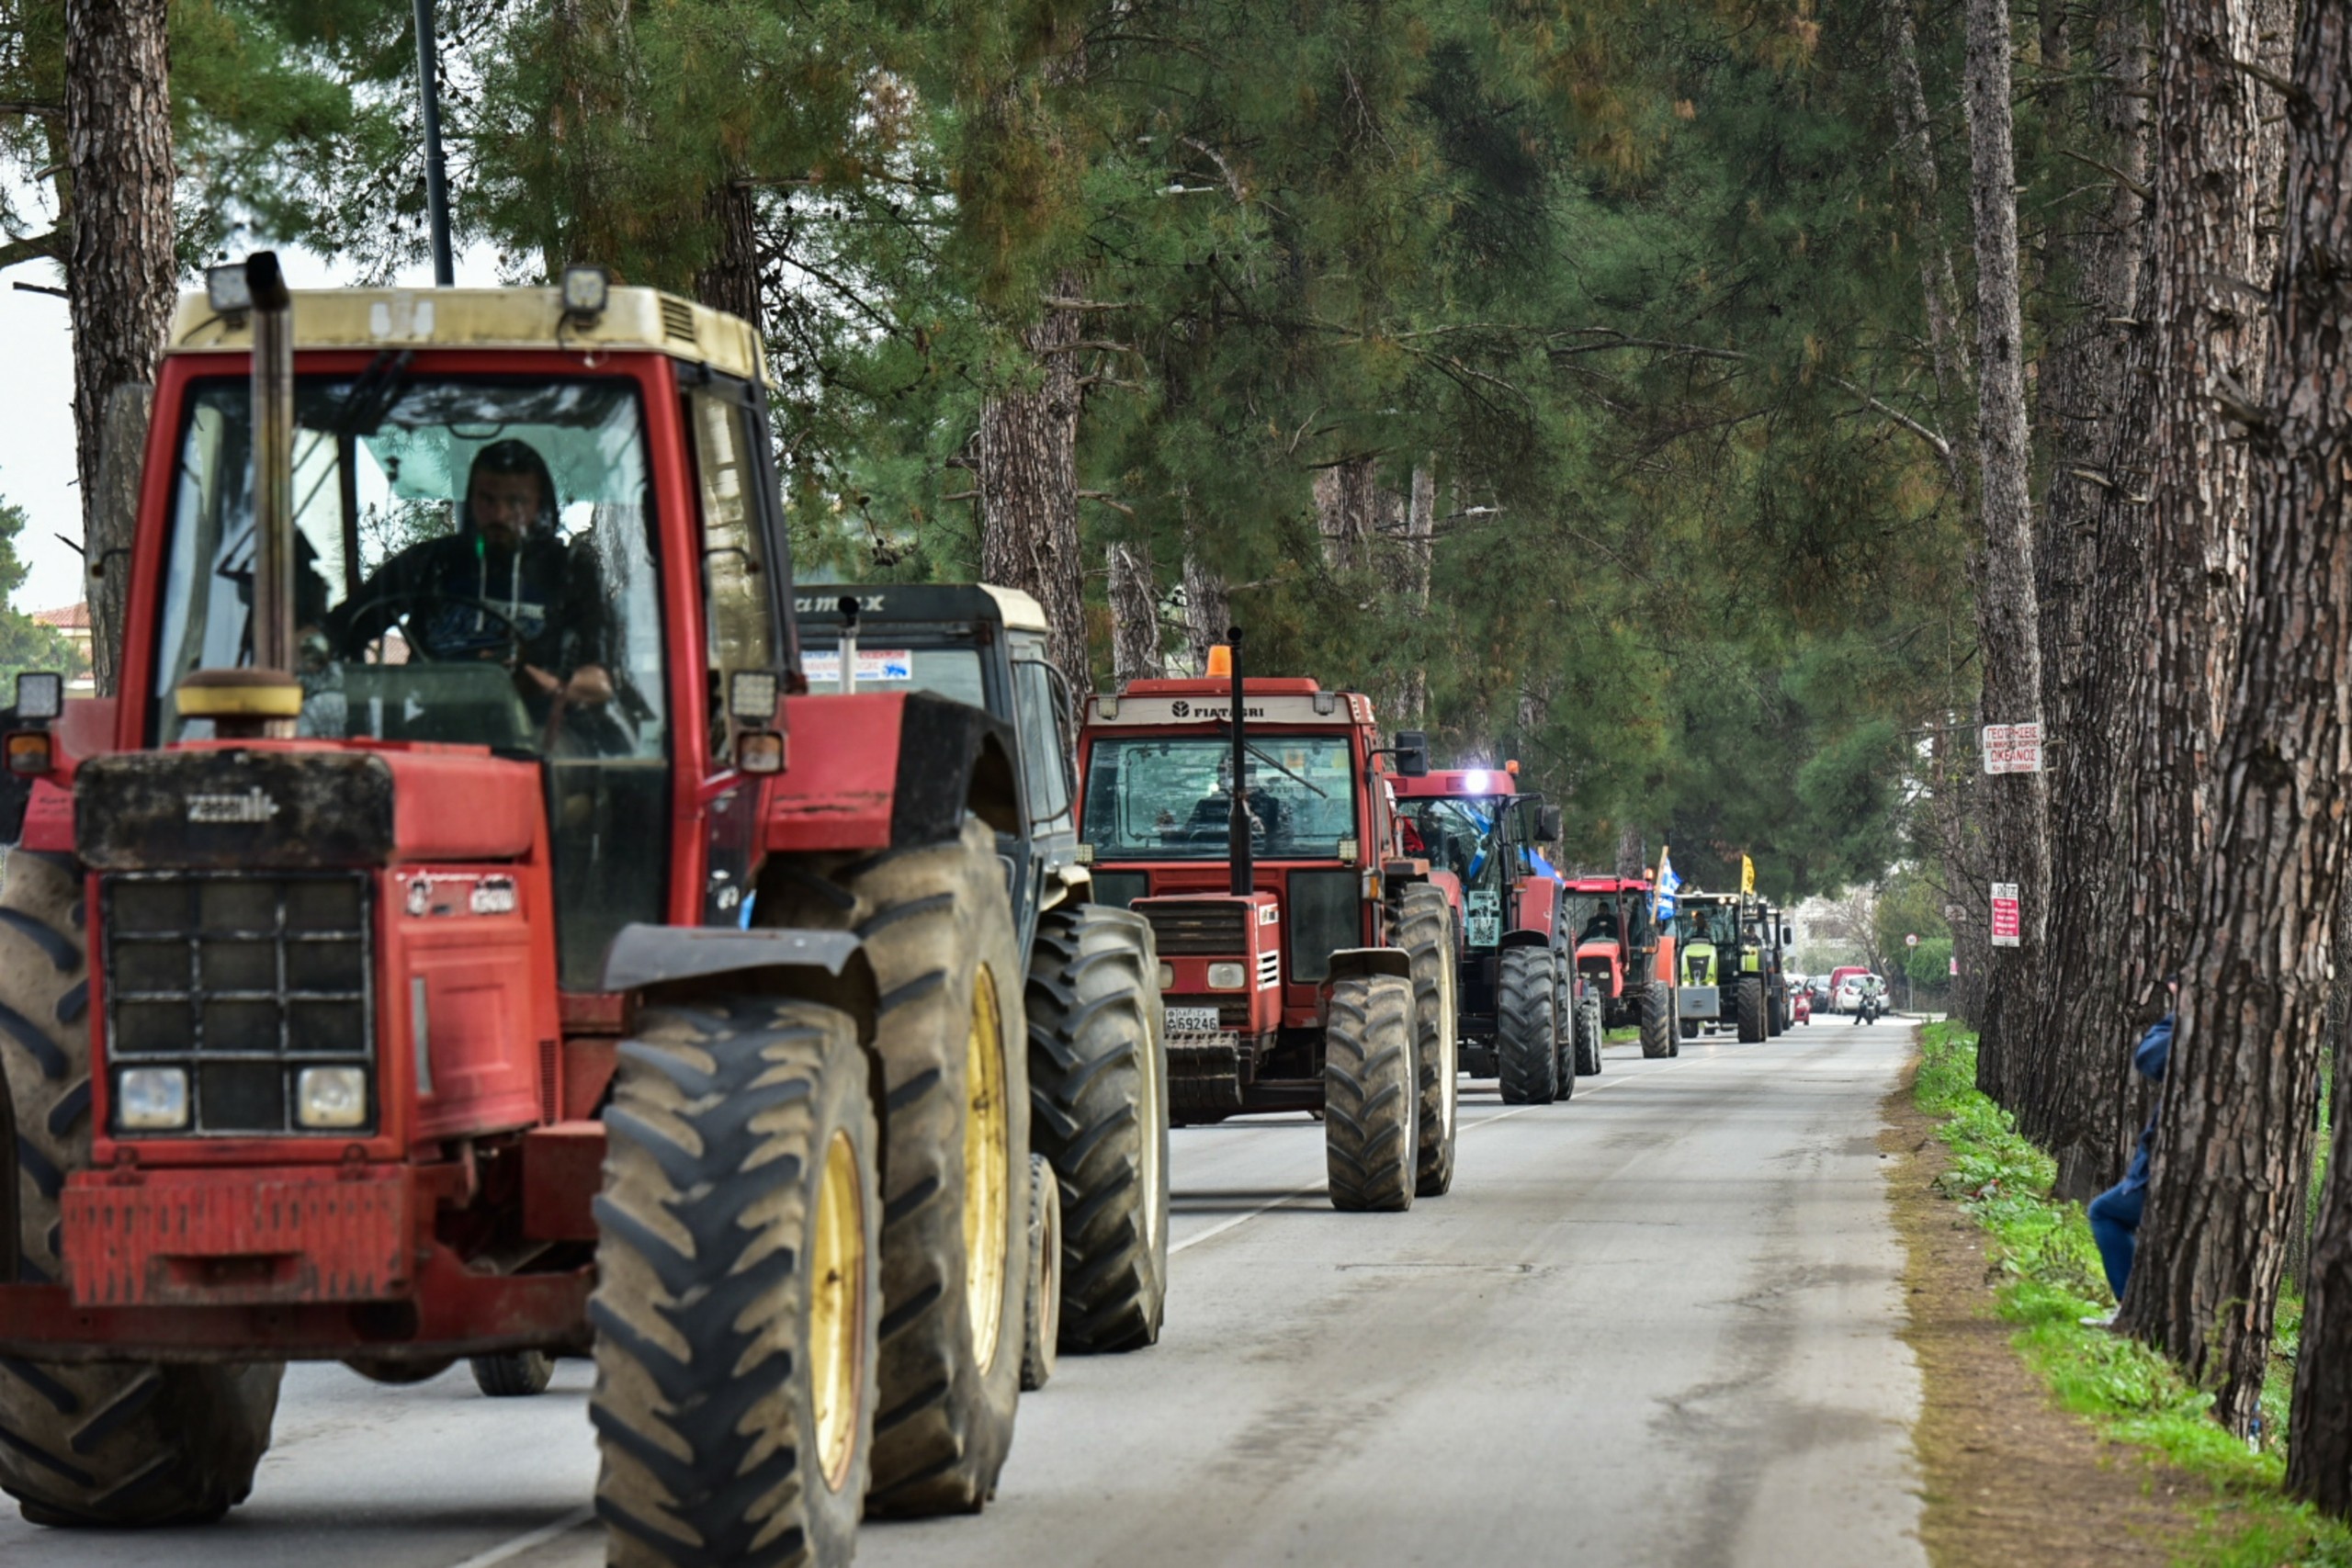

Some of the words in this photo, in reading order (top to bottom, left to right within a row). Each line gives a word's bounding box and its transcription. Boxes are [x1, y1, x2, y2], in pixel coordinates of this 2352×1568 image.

[795, 594, 885, 613] amx
[1194, 707, 1264, 717] FIATGRI
[1991, 750, 2036, 762] ΩΚΕΑΝΟΣ
[1178, 1017, 1216, 1030] 69246
